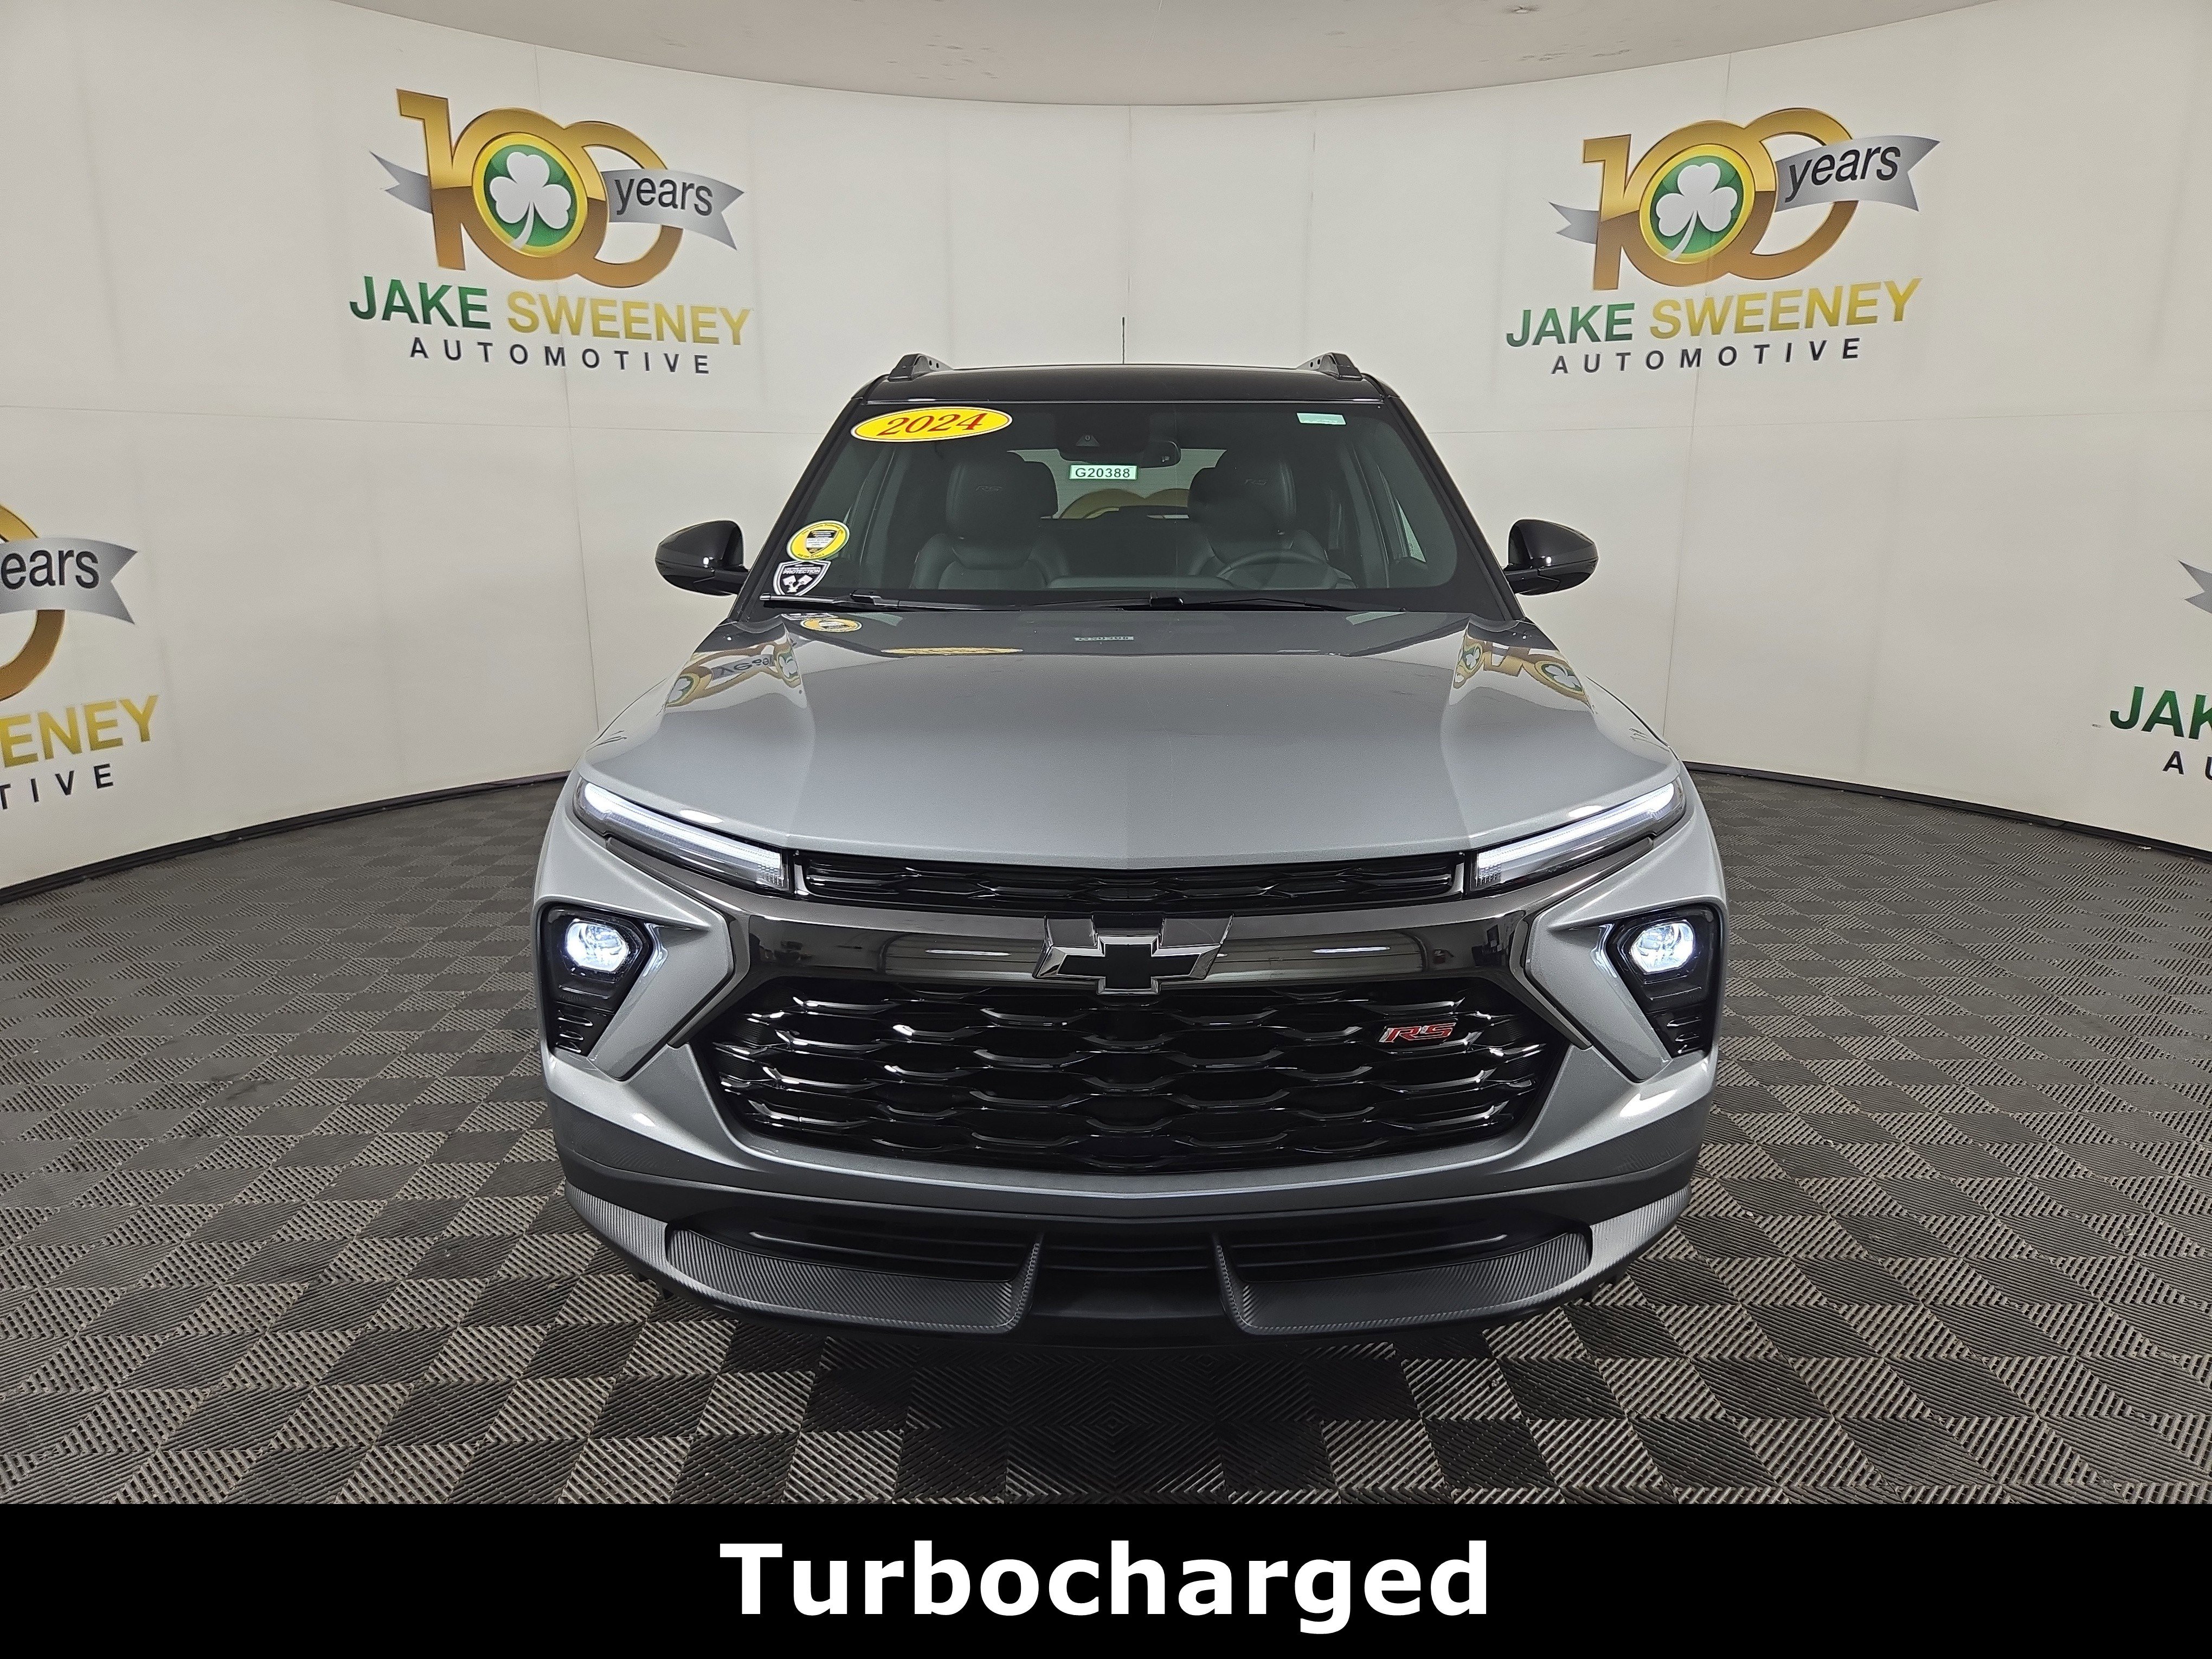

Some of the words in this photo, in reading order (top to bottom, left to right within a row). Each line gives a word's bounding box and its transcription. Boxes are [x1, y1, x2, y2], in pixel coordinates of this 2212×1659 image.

[614, 174, 713, 216] years
[1784, 145, 1901, 203] years
[349, 275, 491, 330] JAKE
[507, 291, 753, 345] SWEENEY
[1506, 303, 1635, 348] JAKE
[1650, 277, 1922, 339] SWEENEY
[410, 337, 709, 374] AUTOMOTIVE
[1551, 337, 1861, 375] AUTOMOTIVE
[876, 413, 988, 436] 2024
[1075, 467, 1130, 478] G20388
[1, 549, 100, 589] ears
[0, 695, 159, 767] ENEY
[2110, 686, 2212, 740] JAK
[0, 763, 114, 809] TIVE
[1379, 1023, 1456, 1043] RS
